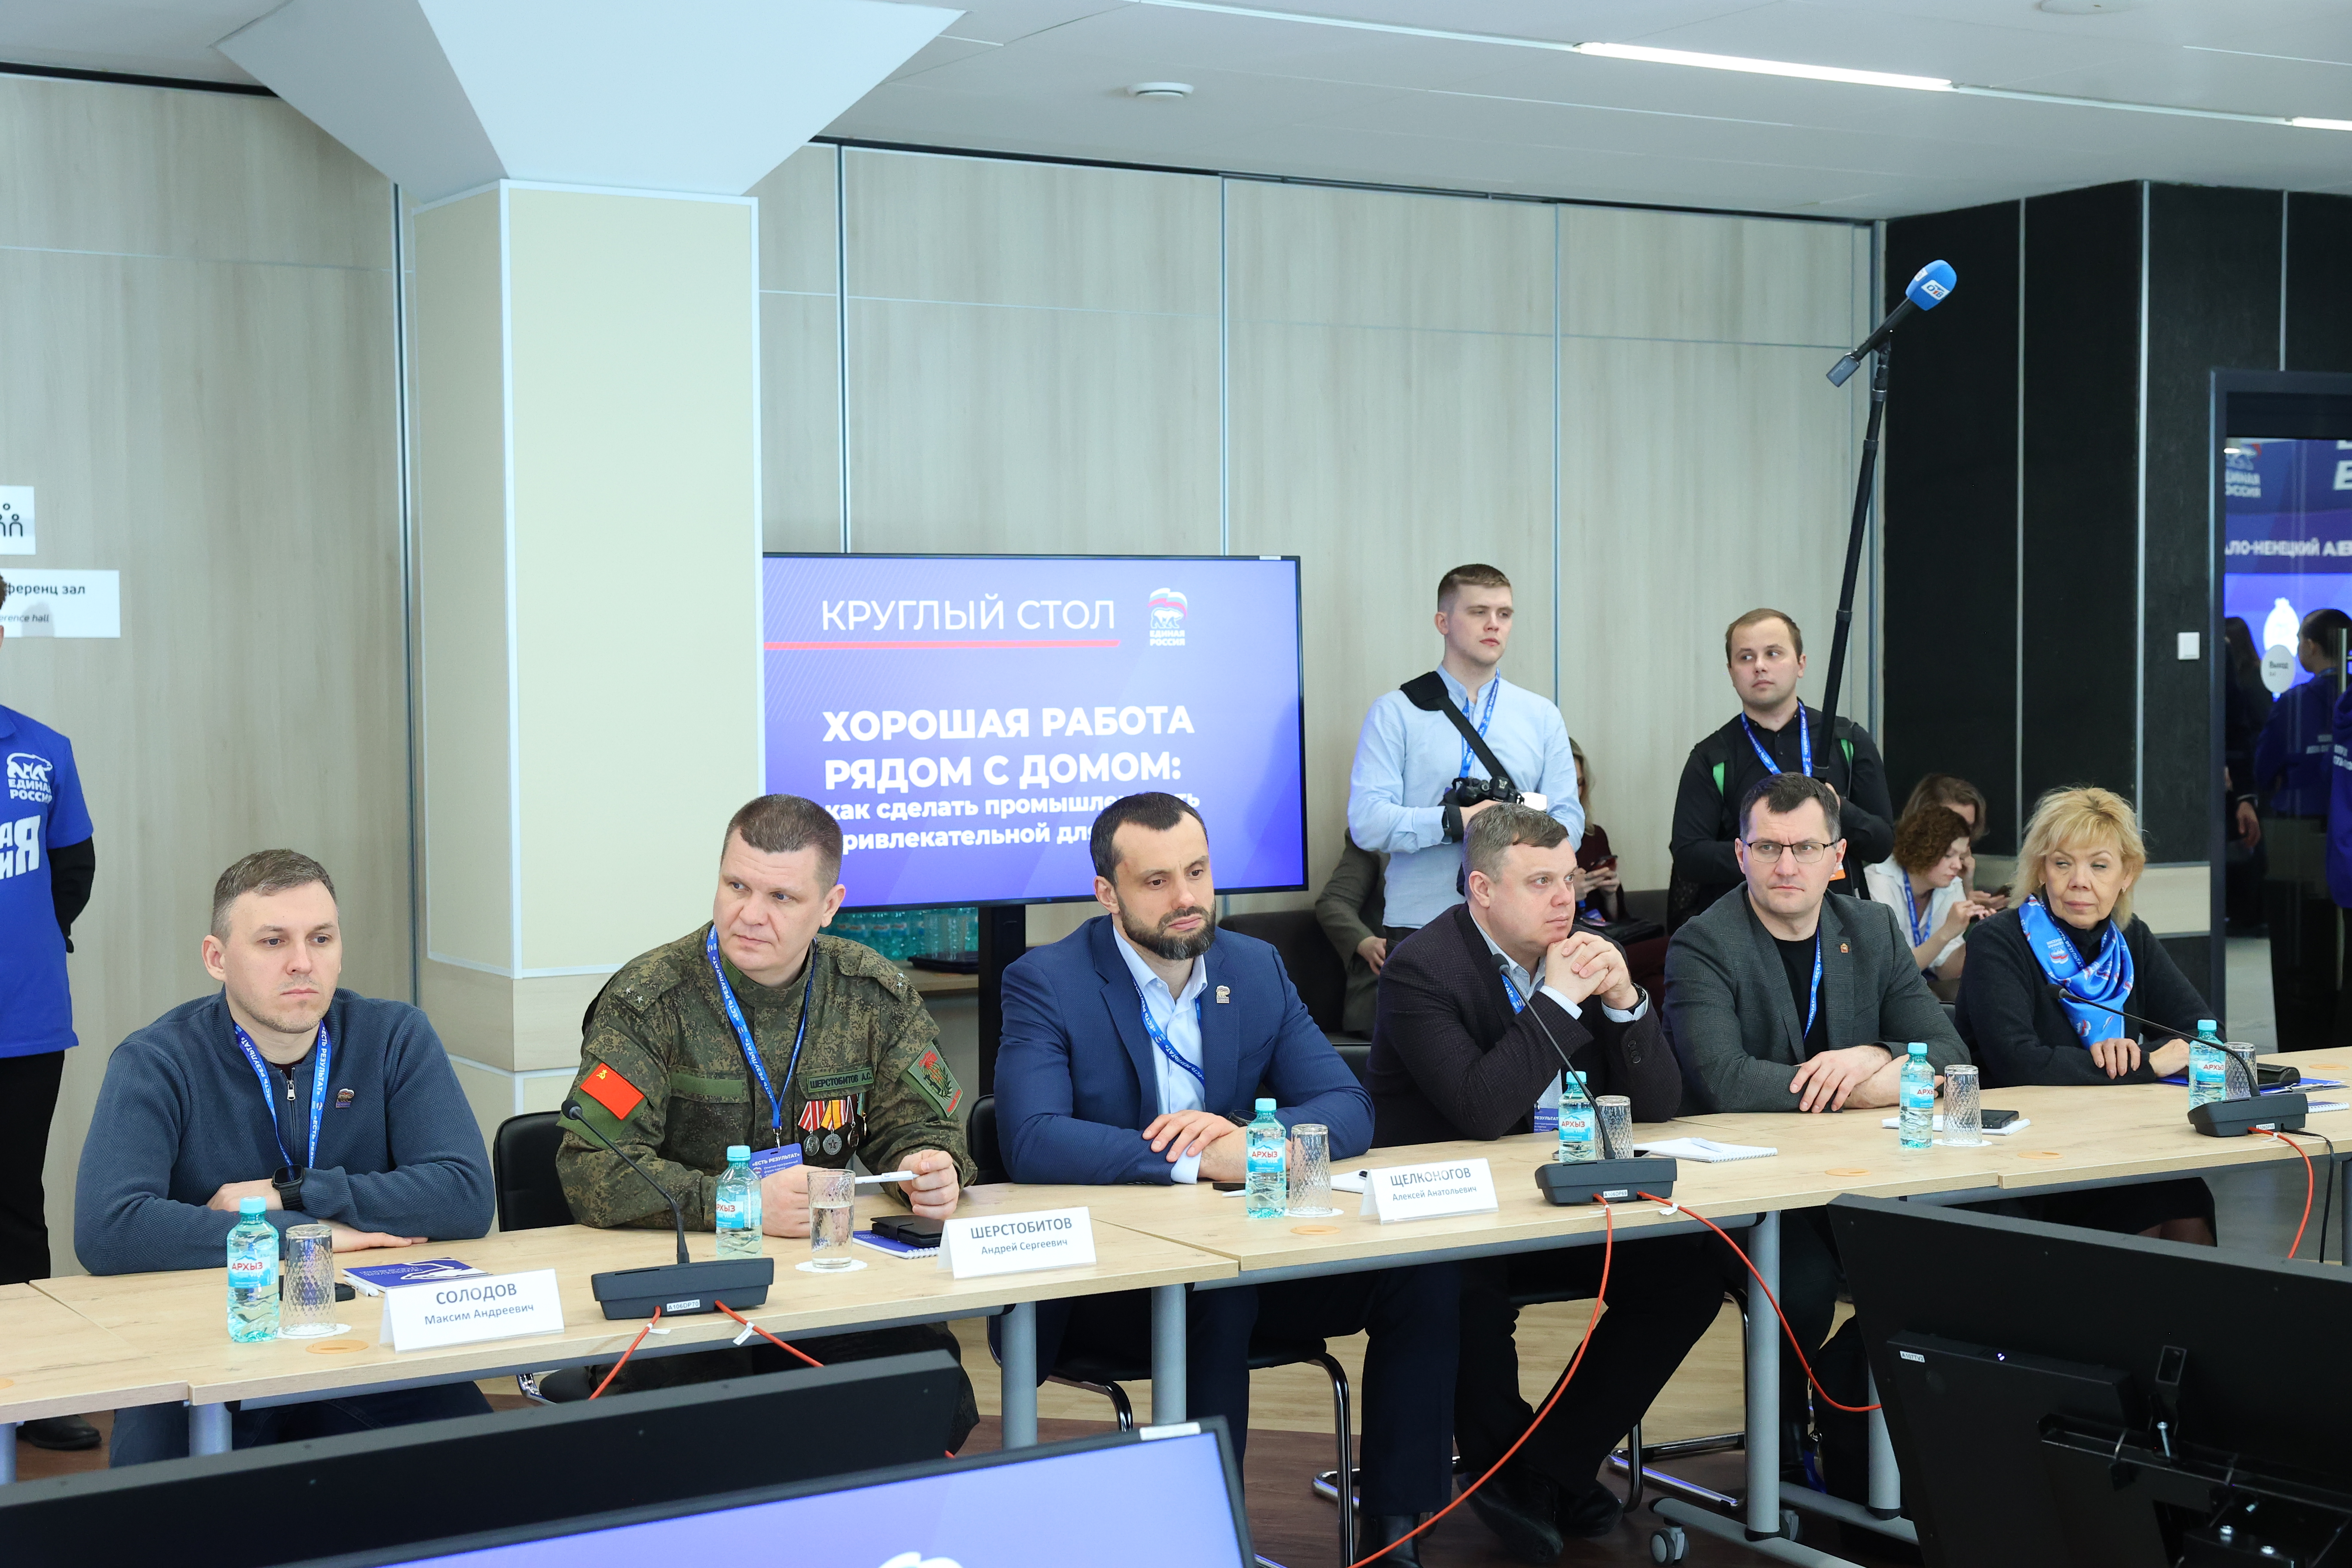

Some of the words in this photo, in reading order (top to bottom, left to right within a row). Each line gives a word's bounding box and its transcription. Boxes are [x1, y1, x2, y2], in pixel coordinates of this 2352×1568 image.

[62, 585, 86, 595] зал
[32, 614, 49, 623] hall
[822, 593, 1004, 631] КРУГЛЫЙ
[1017, 600, 1115, 630] СТОЛ
[1149, 630, 1185, 638] ЕДИНАЯ
[822, 708, 1029, 742] ХОРОШАЯ
[1042, 705, 1195, 737] РАБОТА
[825, 756, 972, 794] РЯДОМ
[983, 755, 1009, 786] С
[1019, 751, 1182, 790] ДОМОМ:
[825, 803, 870, 820] как
[876, 800, 979, 821] сделать
[843, 822, 1050, 855] ривлекательной
[316, 1048, 327, 1096] РЕЗУЛЬТАТ»
[810, 1074, 859, 1089] ШЕРСТОБИТОВ
[861, 1072, 873, 1081] А.С.
[769, 1152, 800, 1163] РЕЗУЛЬТАТ»
[1390, 1167, 1471, 1187] ЩЕЛКОНОГОВ
[1393, 1190, 1426, 1201] Алексей
[1427, 1186, 1477, 1197] Анатольевич
[971, 1217, 1072, 1239] ШЕРСТОБИТОВ
[981, 1243, 1017, 1255] Андрей
[1020, 1238, 1068, 1252] Сергеевич
[231, 1262, 263, 1271] АРХЫЗ
[436, 1283, 517, 1305] СОЛОДОВ
[425, 1312, 471, 1325] Максим
[474, 1304, 534, 1319] Андреевич
[668, 1301, 699, 1311] A106DP70
